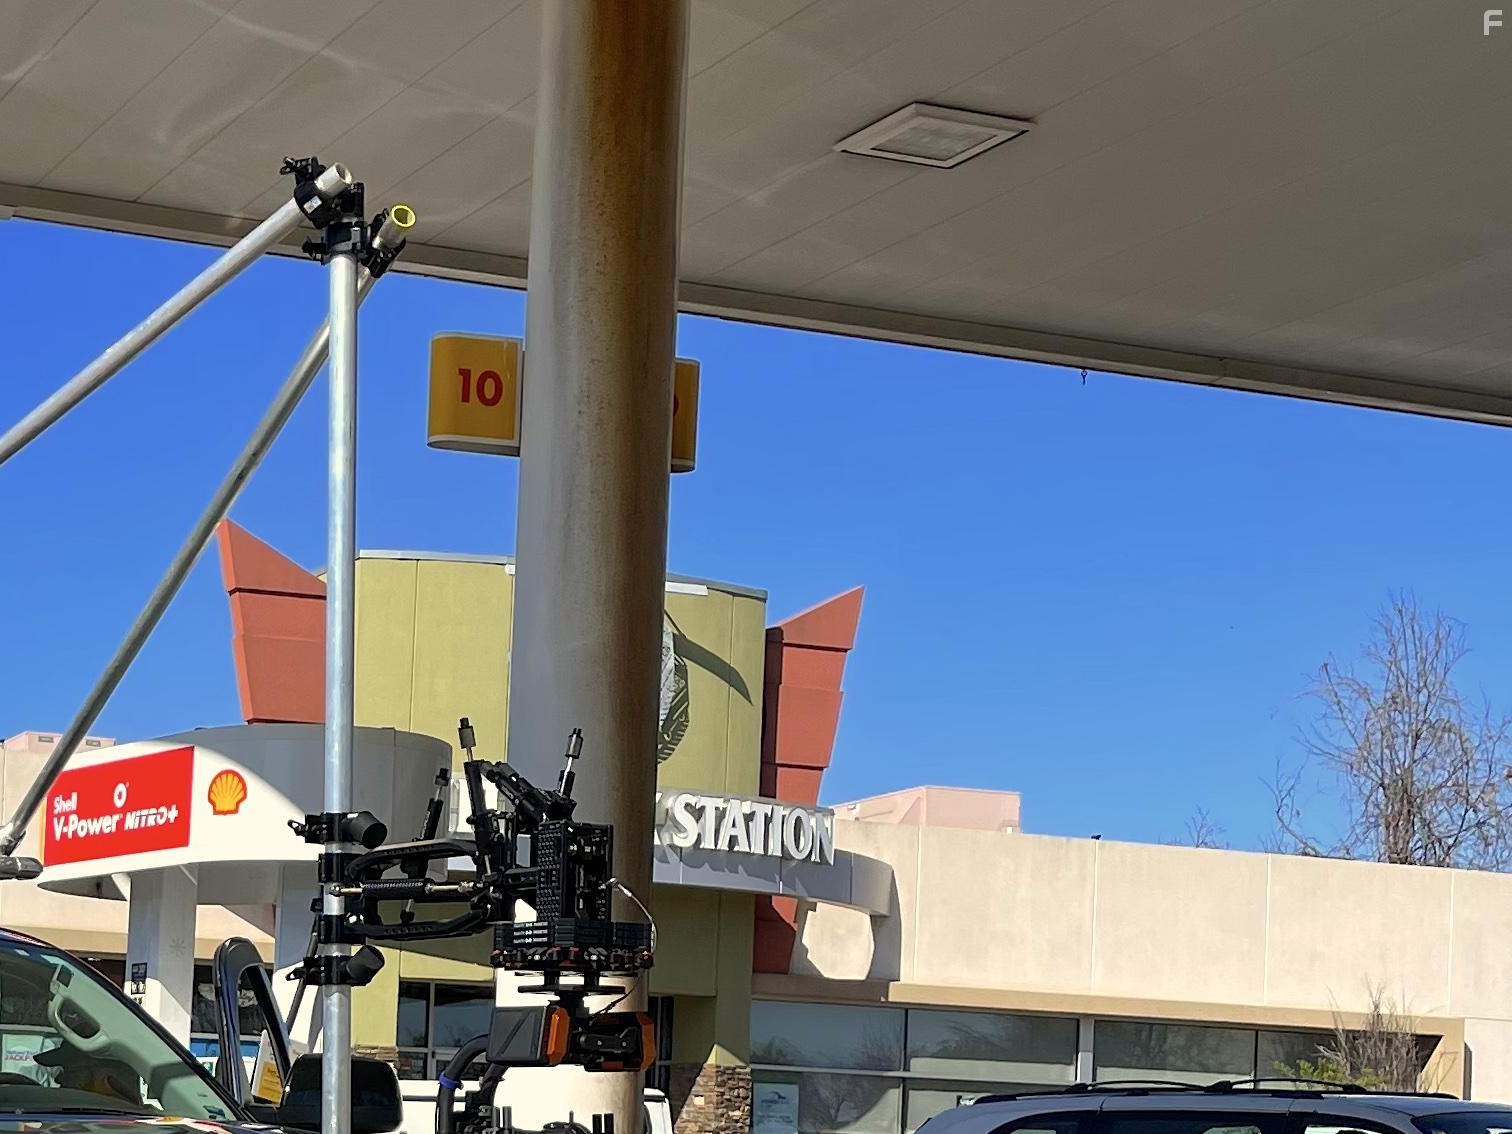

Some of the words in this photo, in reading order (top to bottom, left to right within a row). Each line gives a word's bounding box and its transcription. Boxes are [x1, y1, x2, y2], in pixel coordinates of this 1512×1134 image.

[457, 367, 504, 407] 10
[53, 791, 78, 815] Shell
[53, 813, 119, 841] V-Power
[669, 793, 835, 866] STATION
